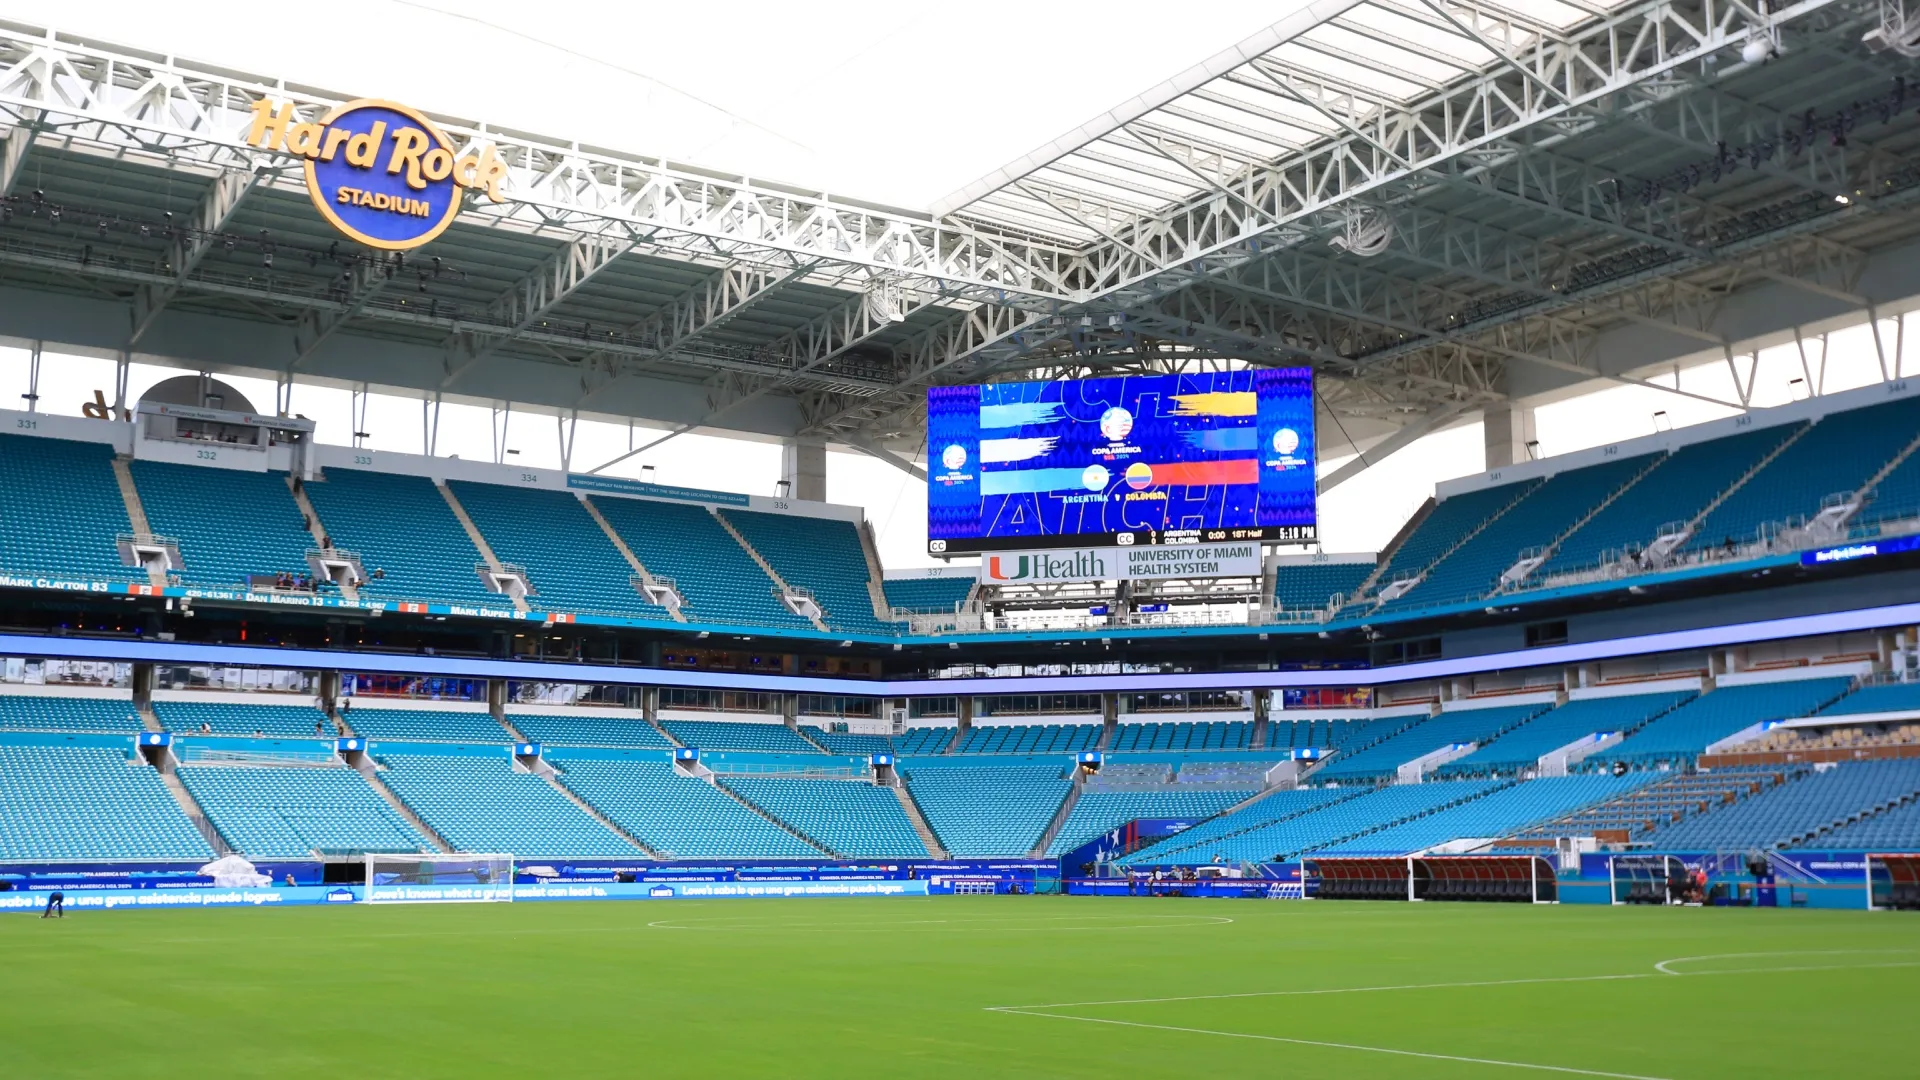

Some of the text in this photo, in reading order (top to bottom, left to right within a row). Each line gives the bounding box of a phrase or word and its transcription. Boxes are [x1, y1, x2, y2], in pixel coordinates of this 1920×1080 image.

[247, 98, 507, 204] Hard Rock
[337, 186, 430, 218] STADIUM
[17, 418, 37, 431] 331
[196, 450, 217, 461] 332
[1092, 447, 1111, 455] COPA
[1604, 446, 1618, 456] 342
[355, 455, 373, 465] 333
[521, 473, 537, 482] 334
[1062, 494, 1109, 503] ARGENTINA
[1125, 491, 1167, 501] COLOMBIA
[774, 501, 789, 510] 336
[1150, 530, 1157, 538] 0
[1163, 529, 1202, 538] ARGENTINA
[1208, 531, 1226, 540] 0:00
[1232, 530, 1247, 538] 1ST
[1248, 529, 1263, 538] Half
[1301, 526, 1315, 539] PM
[1119, 535, 1132, 544] CC
[1164, 537, 1200, 545] COLOMBIA
[931, 542, 944, 551] CC
[1128, 546, 1253, 562] UNIVERSITY OF MIAMI
[1311, 554, 1329, 563] 340
[927, 567, 943, 577] 337
[1128, 562, 1219, 576] HEALTH SYSTEM
[0, 576, 108, 592] MARK CLAYTON 83
[246, 593, 324, 607] DAN MARINO 13
[451, 606, 527, 620] MARK DUPER 85
[406, 888, 442, 899] knows
[443, 888, 472, 898] what
[473, 890, 482, 898] a
[515, 886, 546, 897] assist
[547, 887, 567, 897] can
[569, 886, 593, 897] lead
[593, 885, 608, 897] to.
[682, 882, 905, 897] Lowe's sabe lo que una gran asistencia puede lograr.
[35, 896, 48, 907] lo
[77, 896, 104, 906] una
[105, 895, 136, 908] gran
[138, 892, 201, 905] asistencia
[202, 891, 242, 905] puede
[243, 891, 282, 905] lograr.
